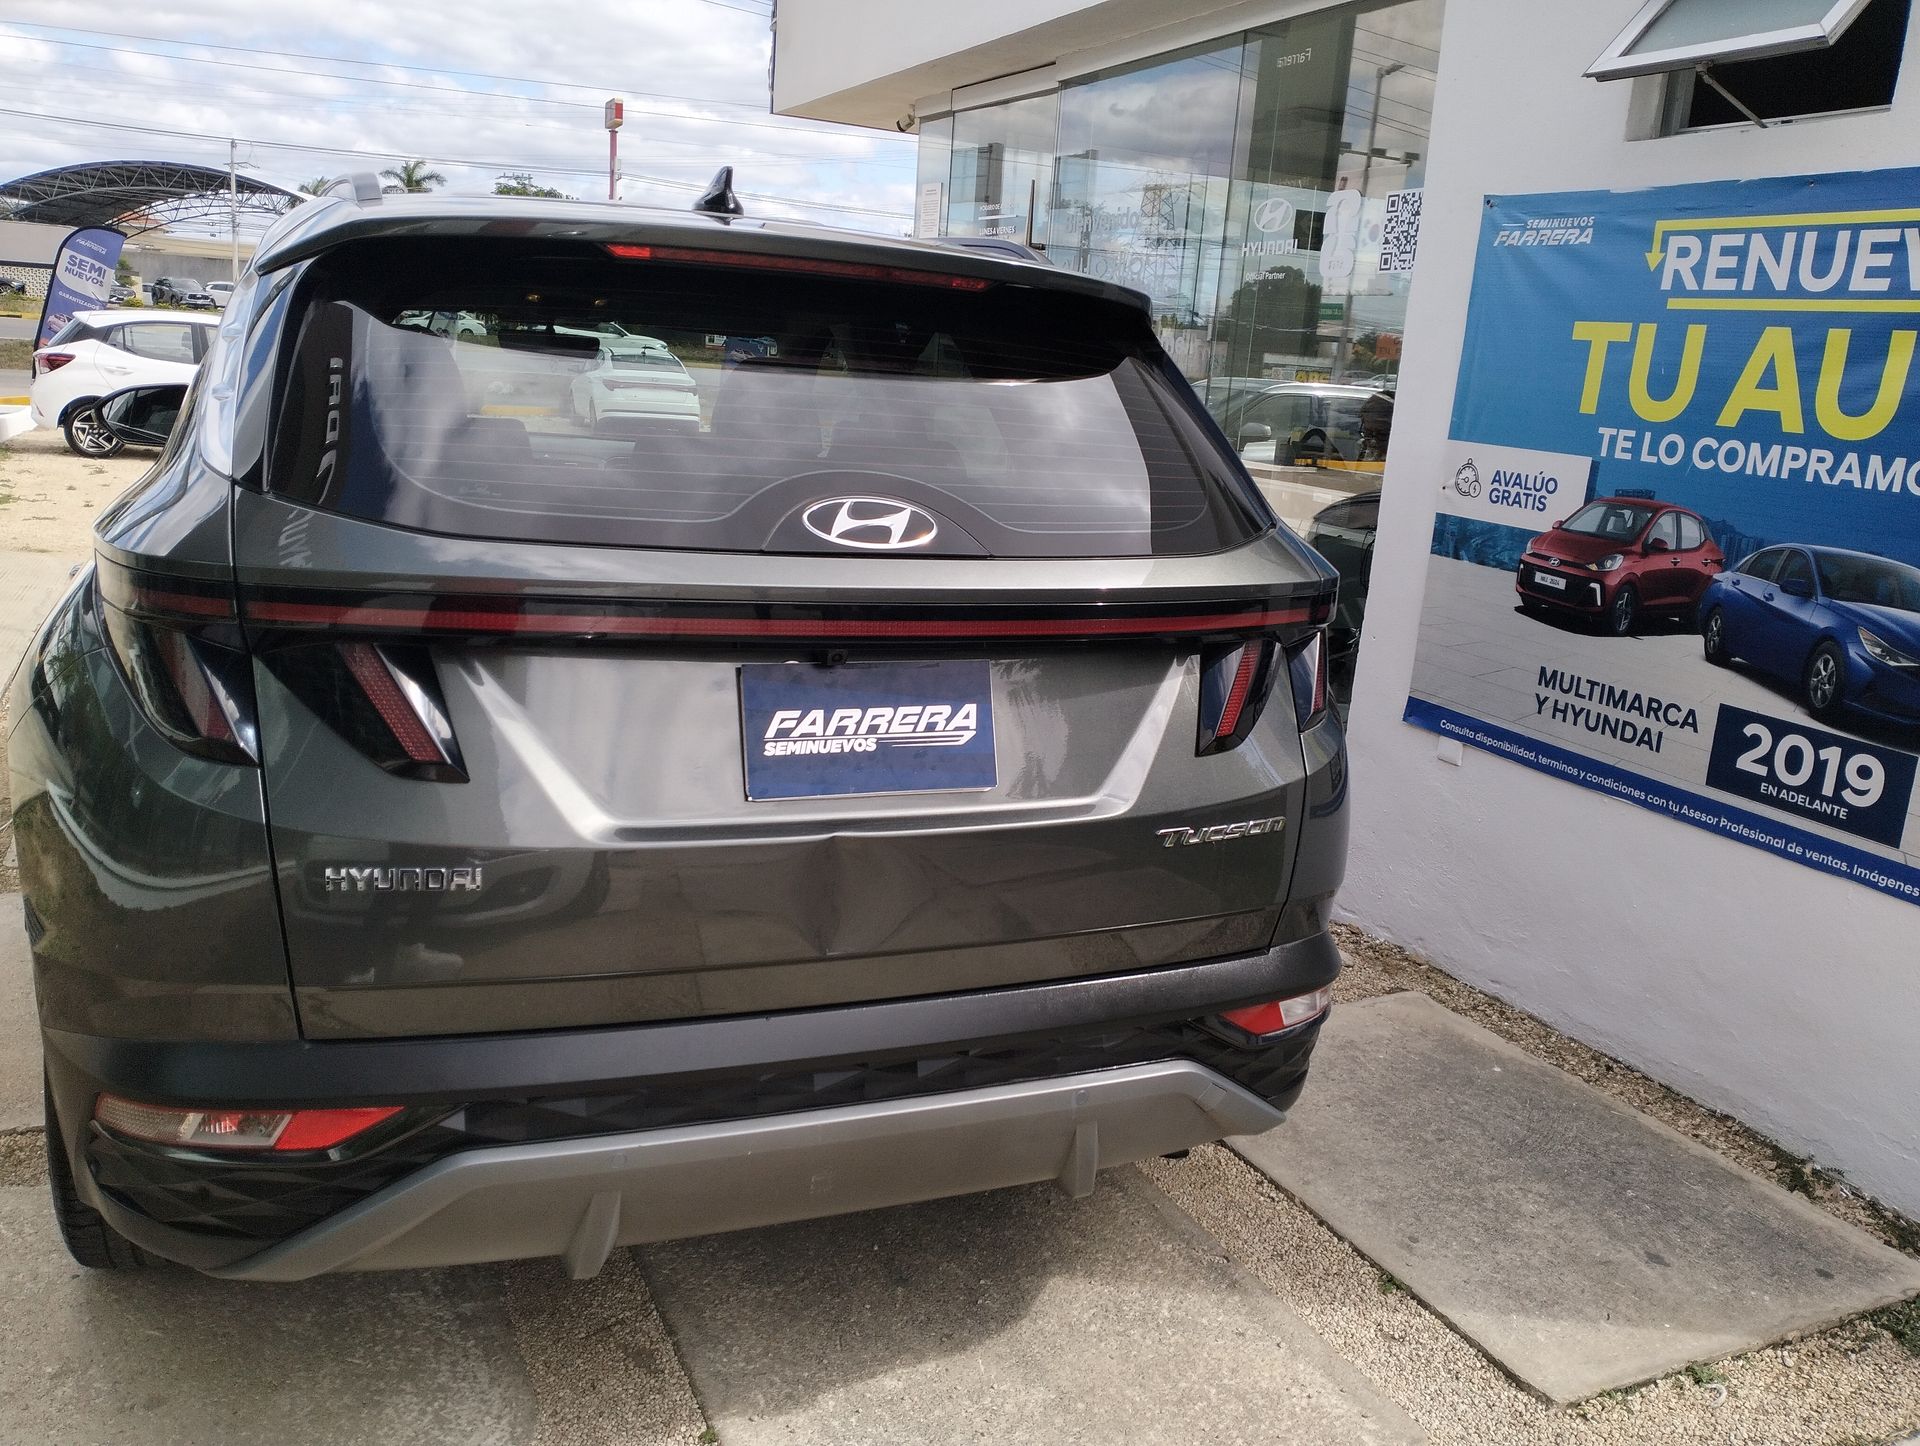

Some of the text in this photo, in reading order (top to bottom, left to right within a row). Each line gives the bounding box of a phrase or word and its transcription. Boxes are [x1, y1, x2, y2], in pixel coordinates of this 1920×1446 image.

[1527, 216, 1595, 229] SEMINUEVOS
[1241, 239, 1298, 256] HYUNDAI
[1493, 228, 1593, 247] FARRERA
[64, 266, 104, 288] NUEVOS
[67, 254, 106, 280] SEMI
[1265, 271, 1286, 280] Partner
[1572, 321, 1707, 422] TU
[1598, 427, 1636, 459] TE
[1640, 431, 1685, 466] LO
[1491, 469, 1558, 495] AVALÚO
[1488, 487, 1547, 512] GRATIS
[1537, 665, 1699, 733] MULTIMARCA
[764, 703, 977, 739] FARRERA
[1534, 692, 1664, 753] Y HYUNDAI
[763, 737, 877, 757] SEMINUEVOS
[1735, 722, 1886, 808] 2019
[1440, 718, 1920, 897] Consulta disponibilidad, terminos y condiciones con tu Asesor Profesional de ventas. Imágenes
[1760, 782, 1849, 820] EN ADELANTE
[325, 867, 482, 891] HYUNDAI
